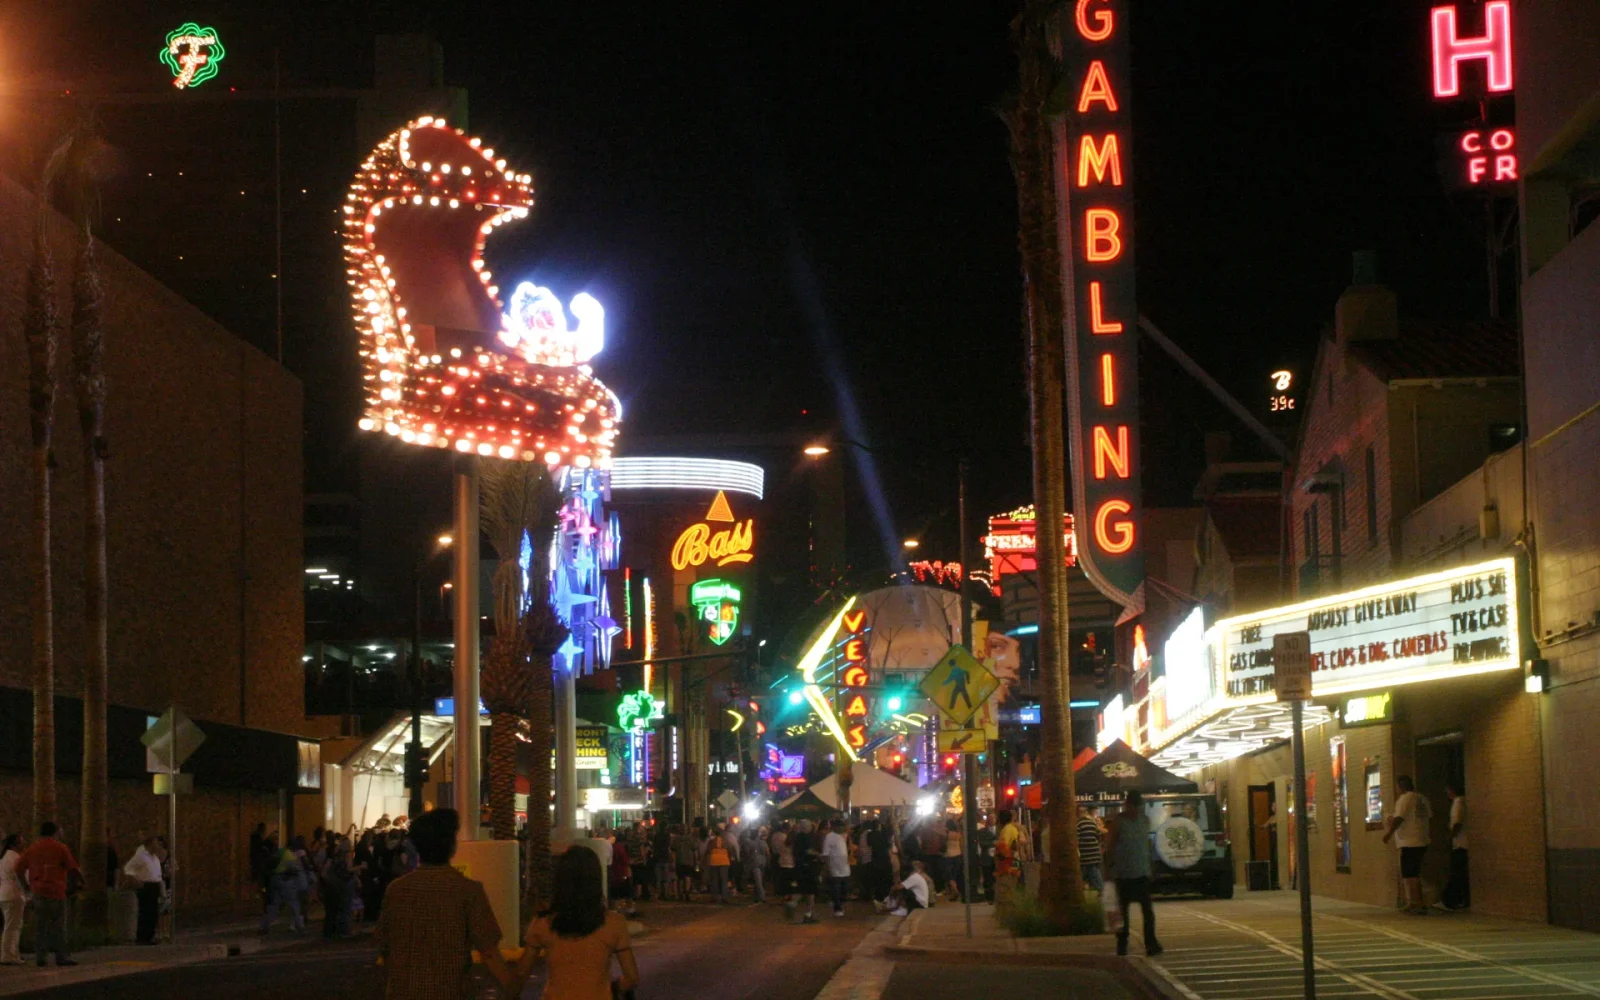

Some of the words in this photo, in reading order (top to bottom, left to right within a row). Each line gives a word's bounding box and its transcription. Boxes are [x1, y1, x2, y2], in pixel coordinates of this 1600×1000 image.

[1431, 1, 1512, 97] H
[1075, 0, 1135, 554] GAMBLING
[671, 519, 753, 571] Bass
[1307, 607, 1348, 632] AUGUST
[1354, 592, 1417, 624] GIVEAWAY
[1451, 578, 1484, 605] PLUS
[1330, 647, 1355, 671] CAPS
[1358, 644, 1366, 665] &
[1393, 630, 1447, 659] CAMERAS
[844, 611, 869, 747] VEGAS
